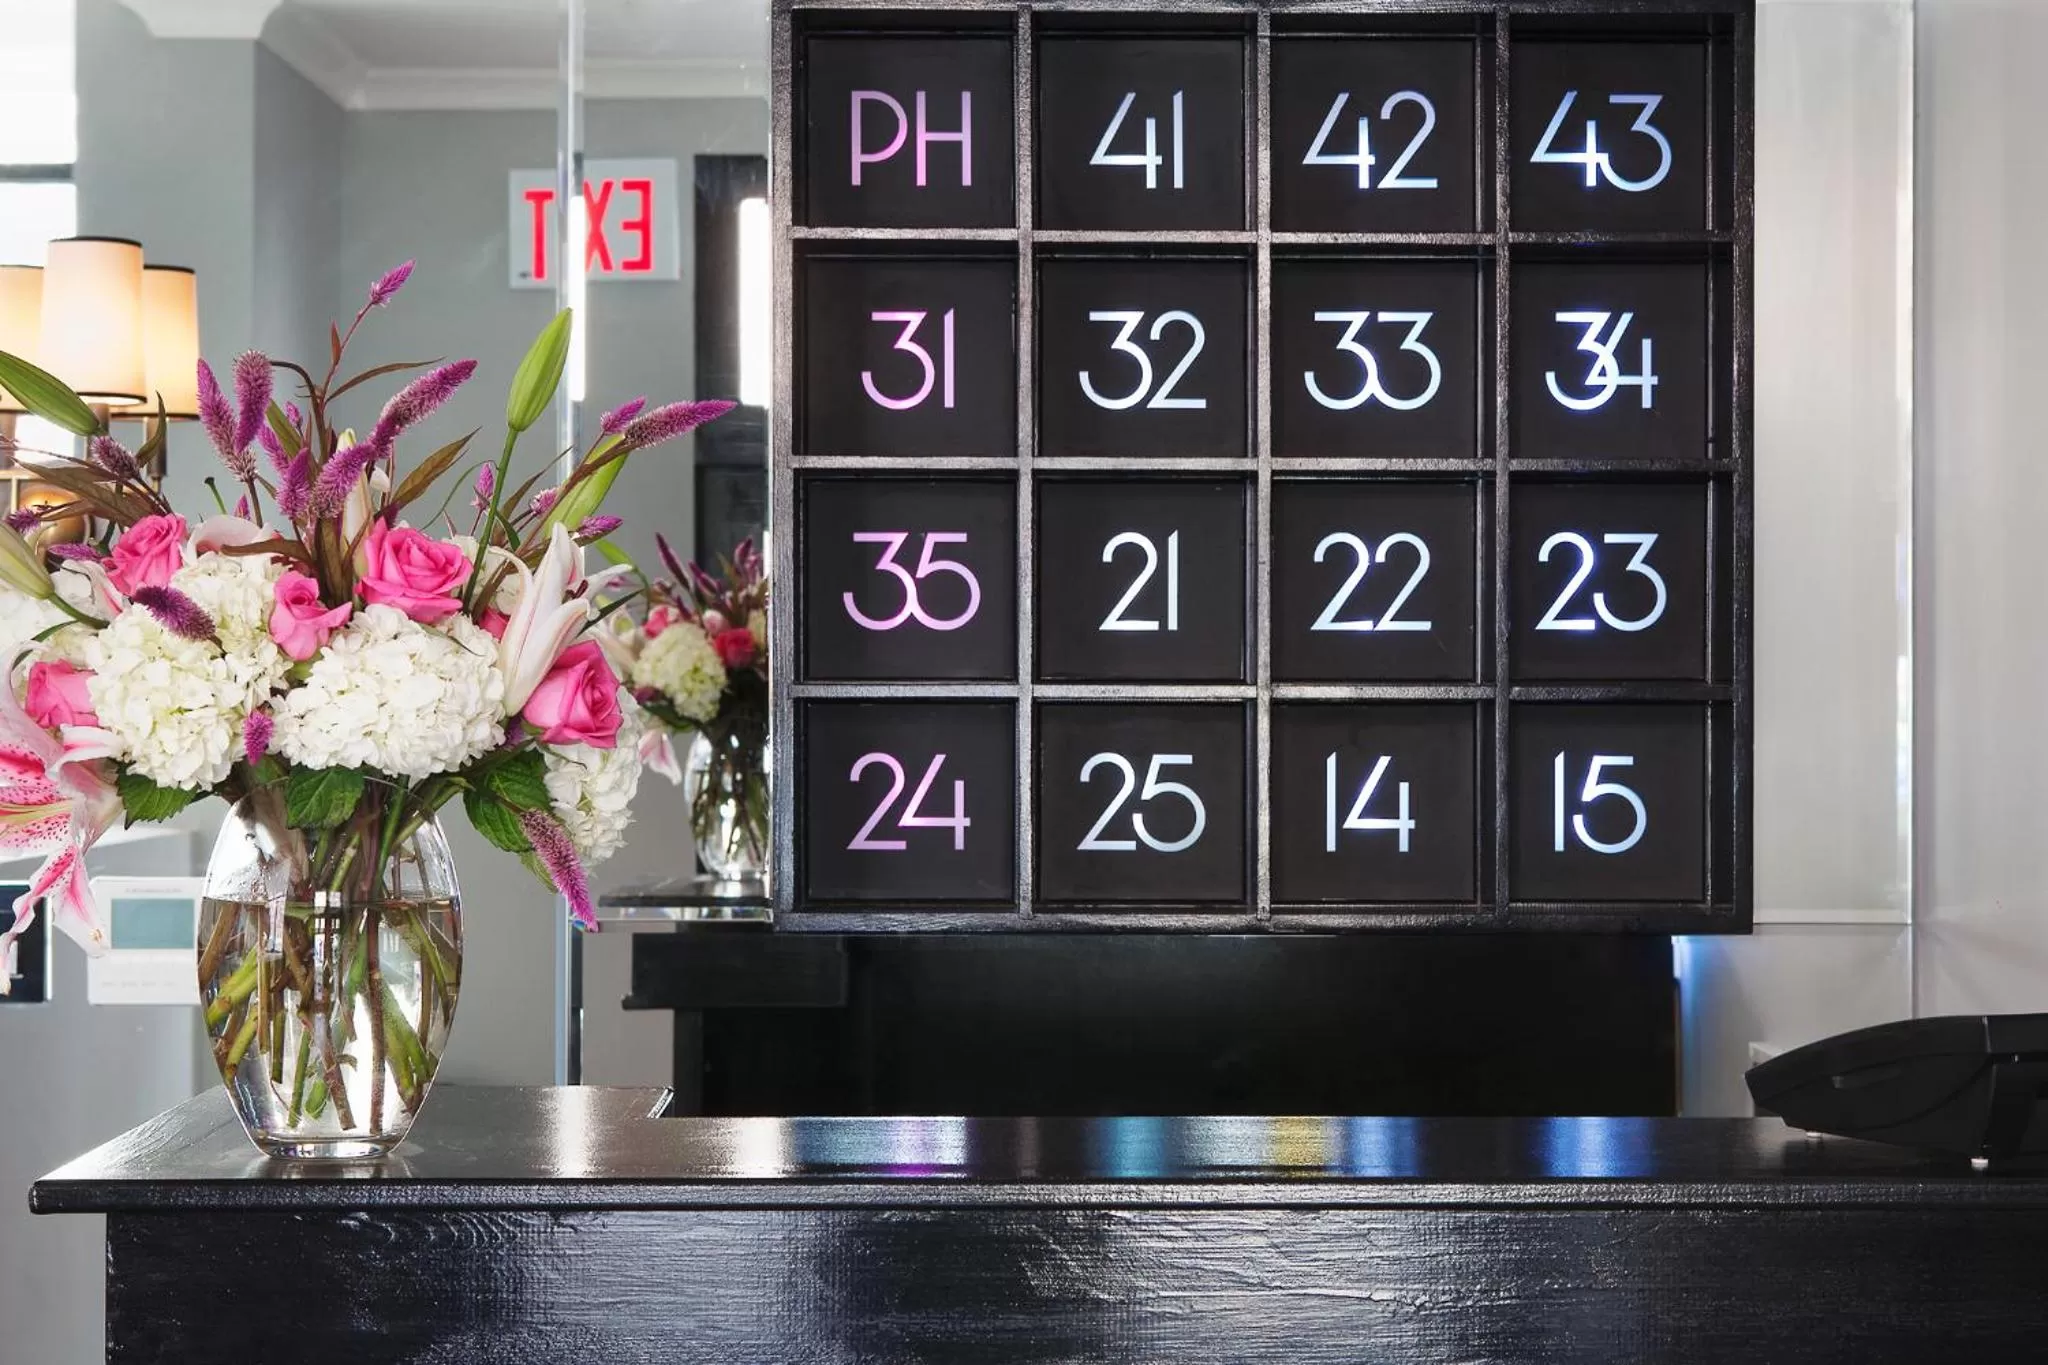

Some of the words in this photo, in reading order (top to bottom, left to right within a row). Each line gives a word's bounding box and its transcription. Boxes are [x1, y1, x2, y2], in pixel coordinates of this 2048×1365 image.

[851, 90, 972, 187] PH
[1089, 90, 1184, 189] 41
[1302, 90, 1438, 190] 42
[1529, 90, 1672, 192] 43
[861, 307, 955, 410] 31
[1078, 310, 1207, 410] 32
[1303, 310, 1442, 411] 33
[1545, 310, 1659, 412] 34
[843, 531, 981, 631] 35
[1098, 529, 1179, 632] 21
[1310, 531, 1432, 632] 22
[1534, 531, 1667, 634] 23
[847, 752, 971, 851] 24
[1076, 751, 1206, 853] 25
[1326, 751, 1416, 853] 14
[1554, 751, 1647, 854] 15
